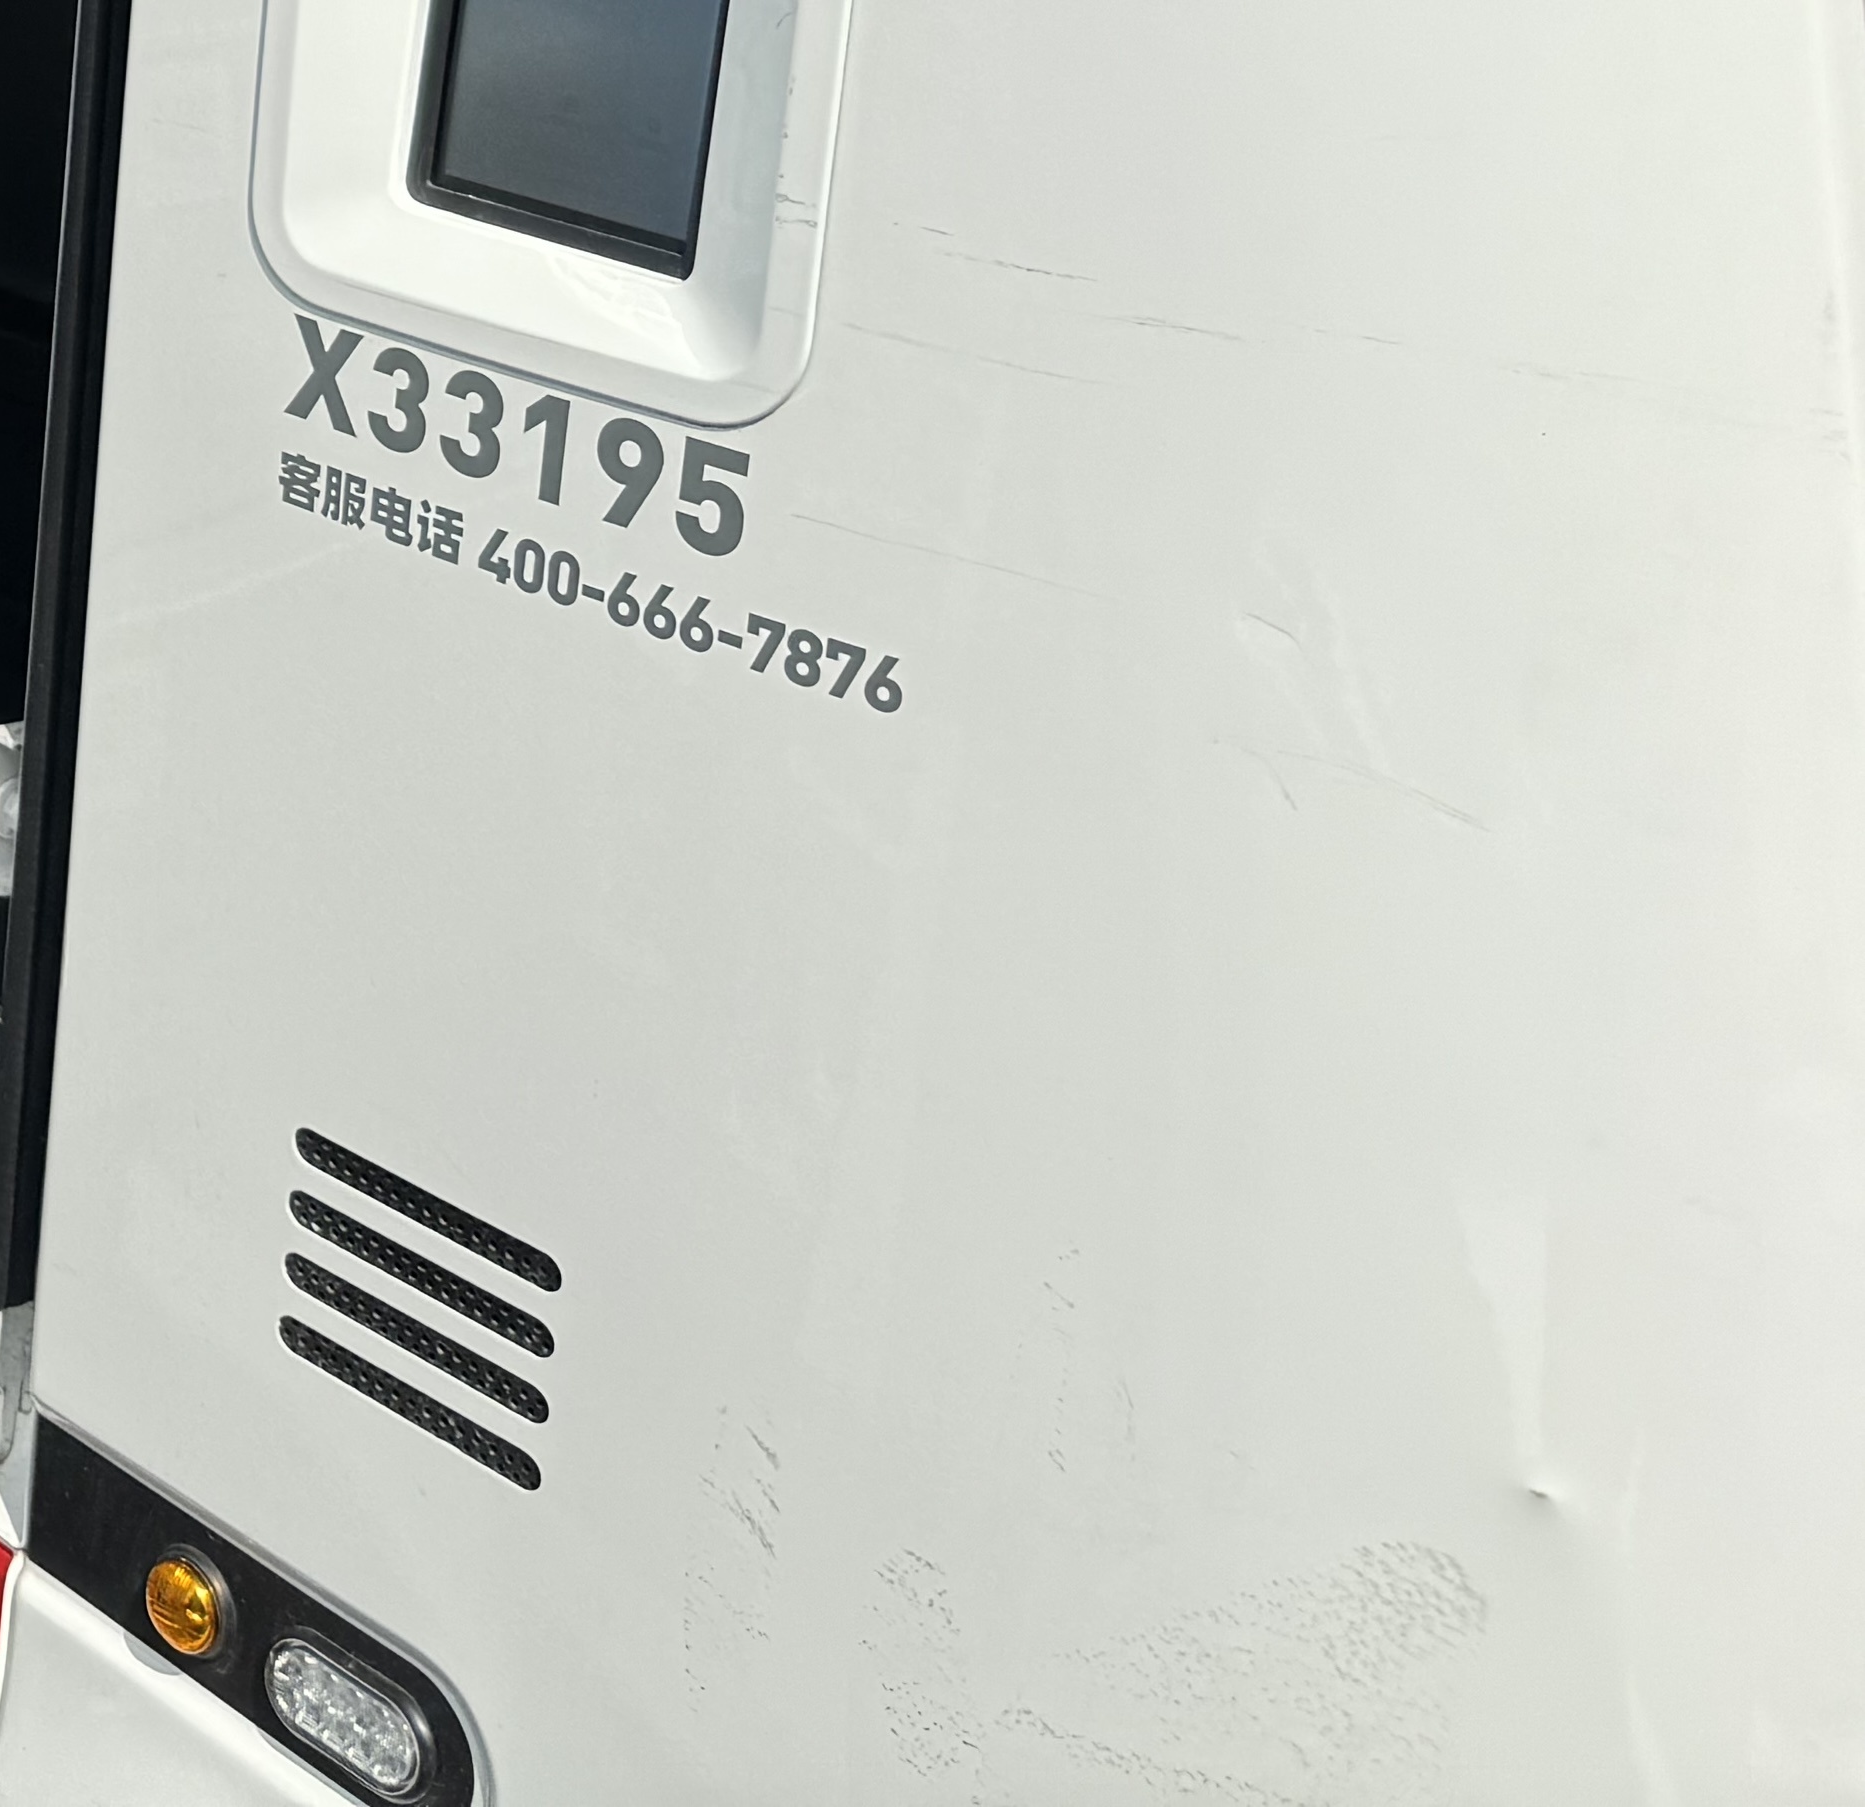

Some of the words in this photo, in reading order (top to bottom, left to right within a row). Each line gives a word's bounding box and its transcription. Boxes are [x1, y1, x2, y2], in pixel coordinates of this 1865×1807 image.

[284, 313, 750, 556] X33195
[278, 452, 464, 565] 客服电话
[478, 528, 903, 713] 400-666-7876
